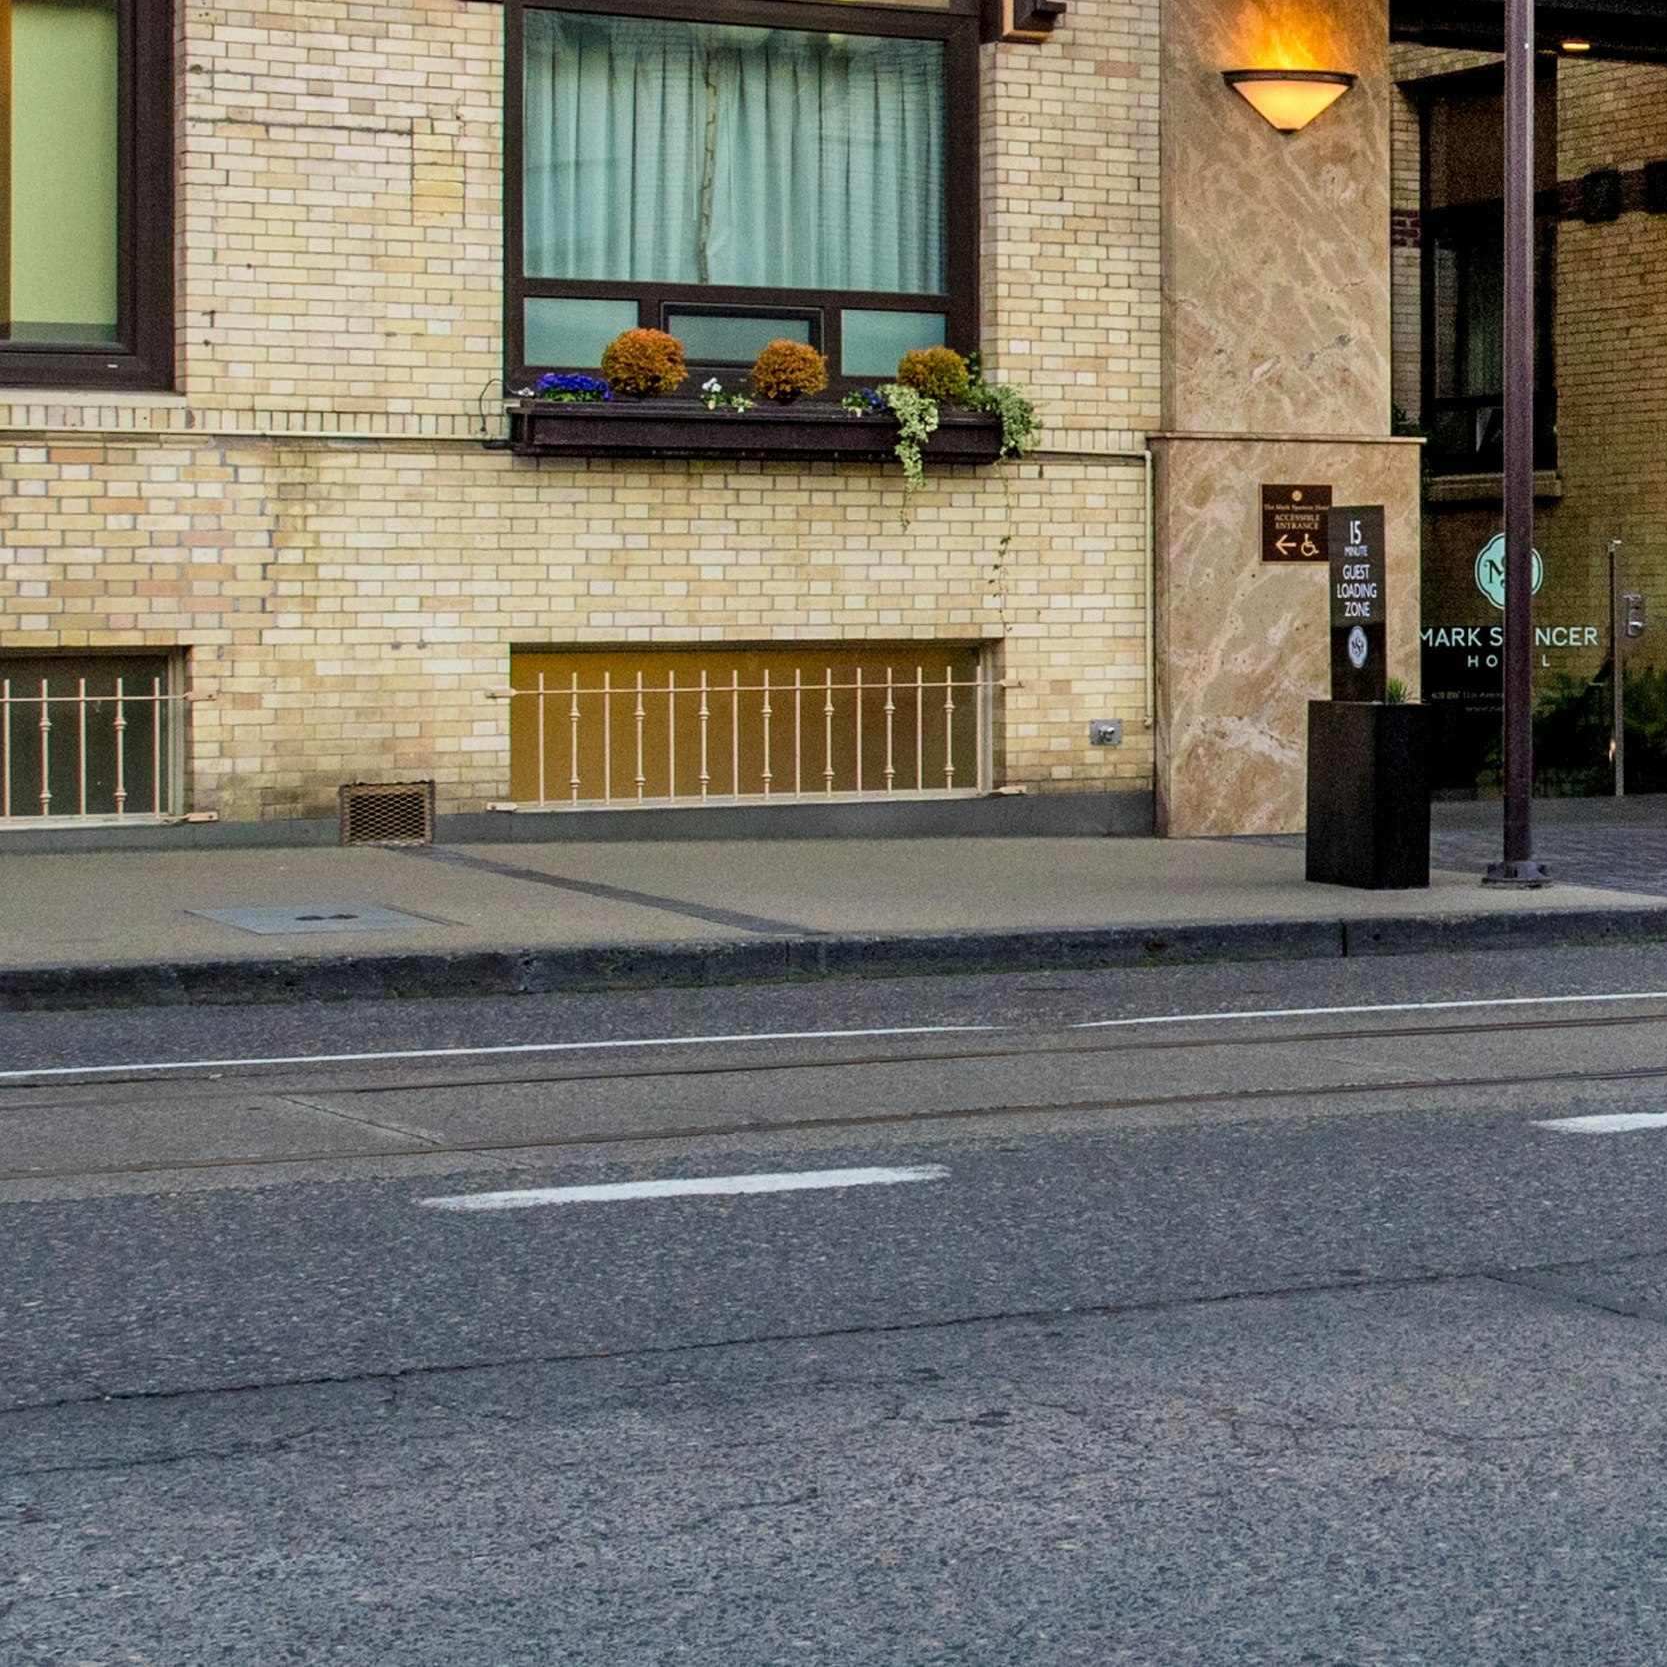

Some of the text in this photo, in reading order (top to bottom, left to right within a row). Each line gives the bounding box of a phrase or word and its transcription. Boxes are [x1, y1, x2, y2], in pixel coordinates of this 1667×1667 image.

[1274, 513, 1320, 522] ACCESSIBLE
[1275, 522, 1319, 530] ENTRANCE
[1349, 520, 1362, 544] 15
[1344, 545, 1368, 557] MINUTE
[1343, 564, 1370, 580] GUEST
[1337, 582, 1377, 599] LOADING
[1344, 601, 1371, 617] ZONE
[1489, 627, 1598, 647] SNCER
[1467, 654, 1550, 668] HOL
